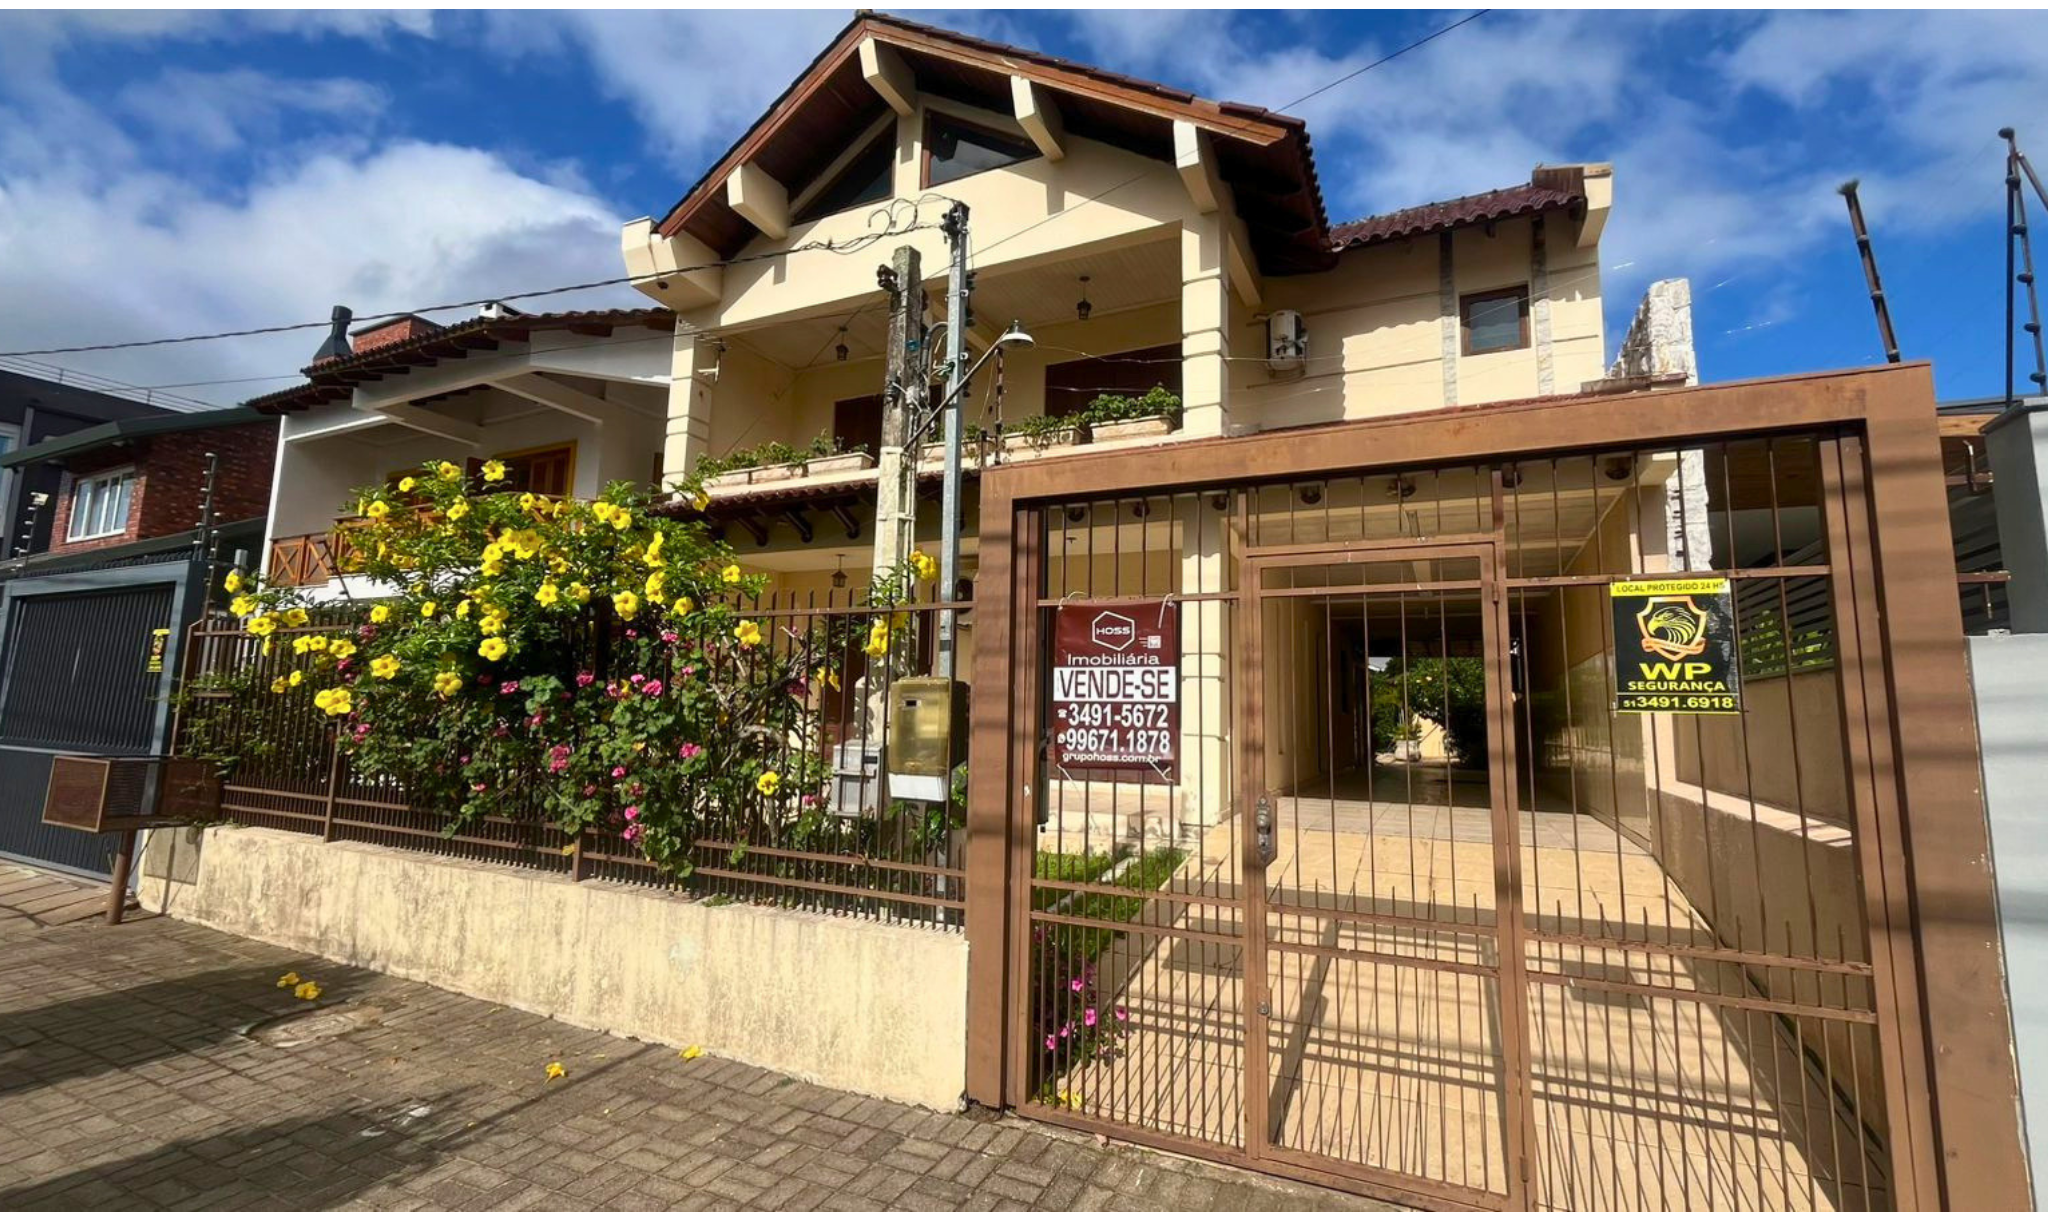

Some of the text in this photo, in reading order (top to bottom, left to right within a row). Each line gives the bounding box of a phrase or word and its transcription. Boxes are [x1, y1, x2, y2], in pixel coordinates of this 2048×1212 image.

[1616, 583, 1645, 593] LOCAL
[1647, 582, 1698, 592] PROTEGIDO
[1701, 582, 1711, 590] 24
[1096, 626, 1131, 636] HOSS
[1067, 653, 1160, 666] Imobiliária
[1639, 663, 1712, 681] WP
[1059, 669, 1170, 699] VENDE-SE
[1627, 681, 1725, 693] SEGURANÇA
[1623, 696, 1734, 709] 51 3491.6918
[1068, 703, 1169, 728] 3491-5672
[1066, 728, 1171, 754] 99671.1878
[1062, 752, 1162, 763] grupohoss.com.br
